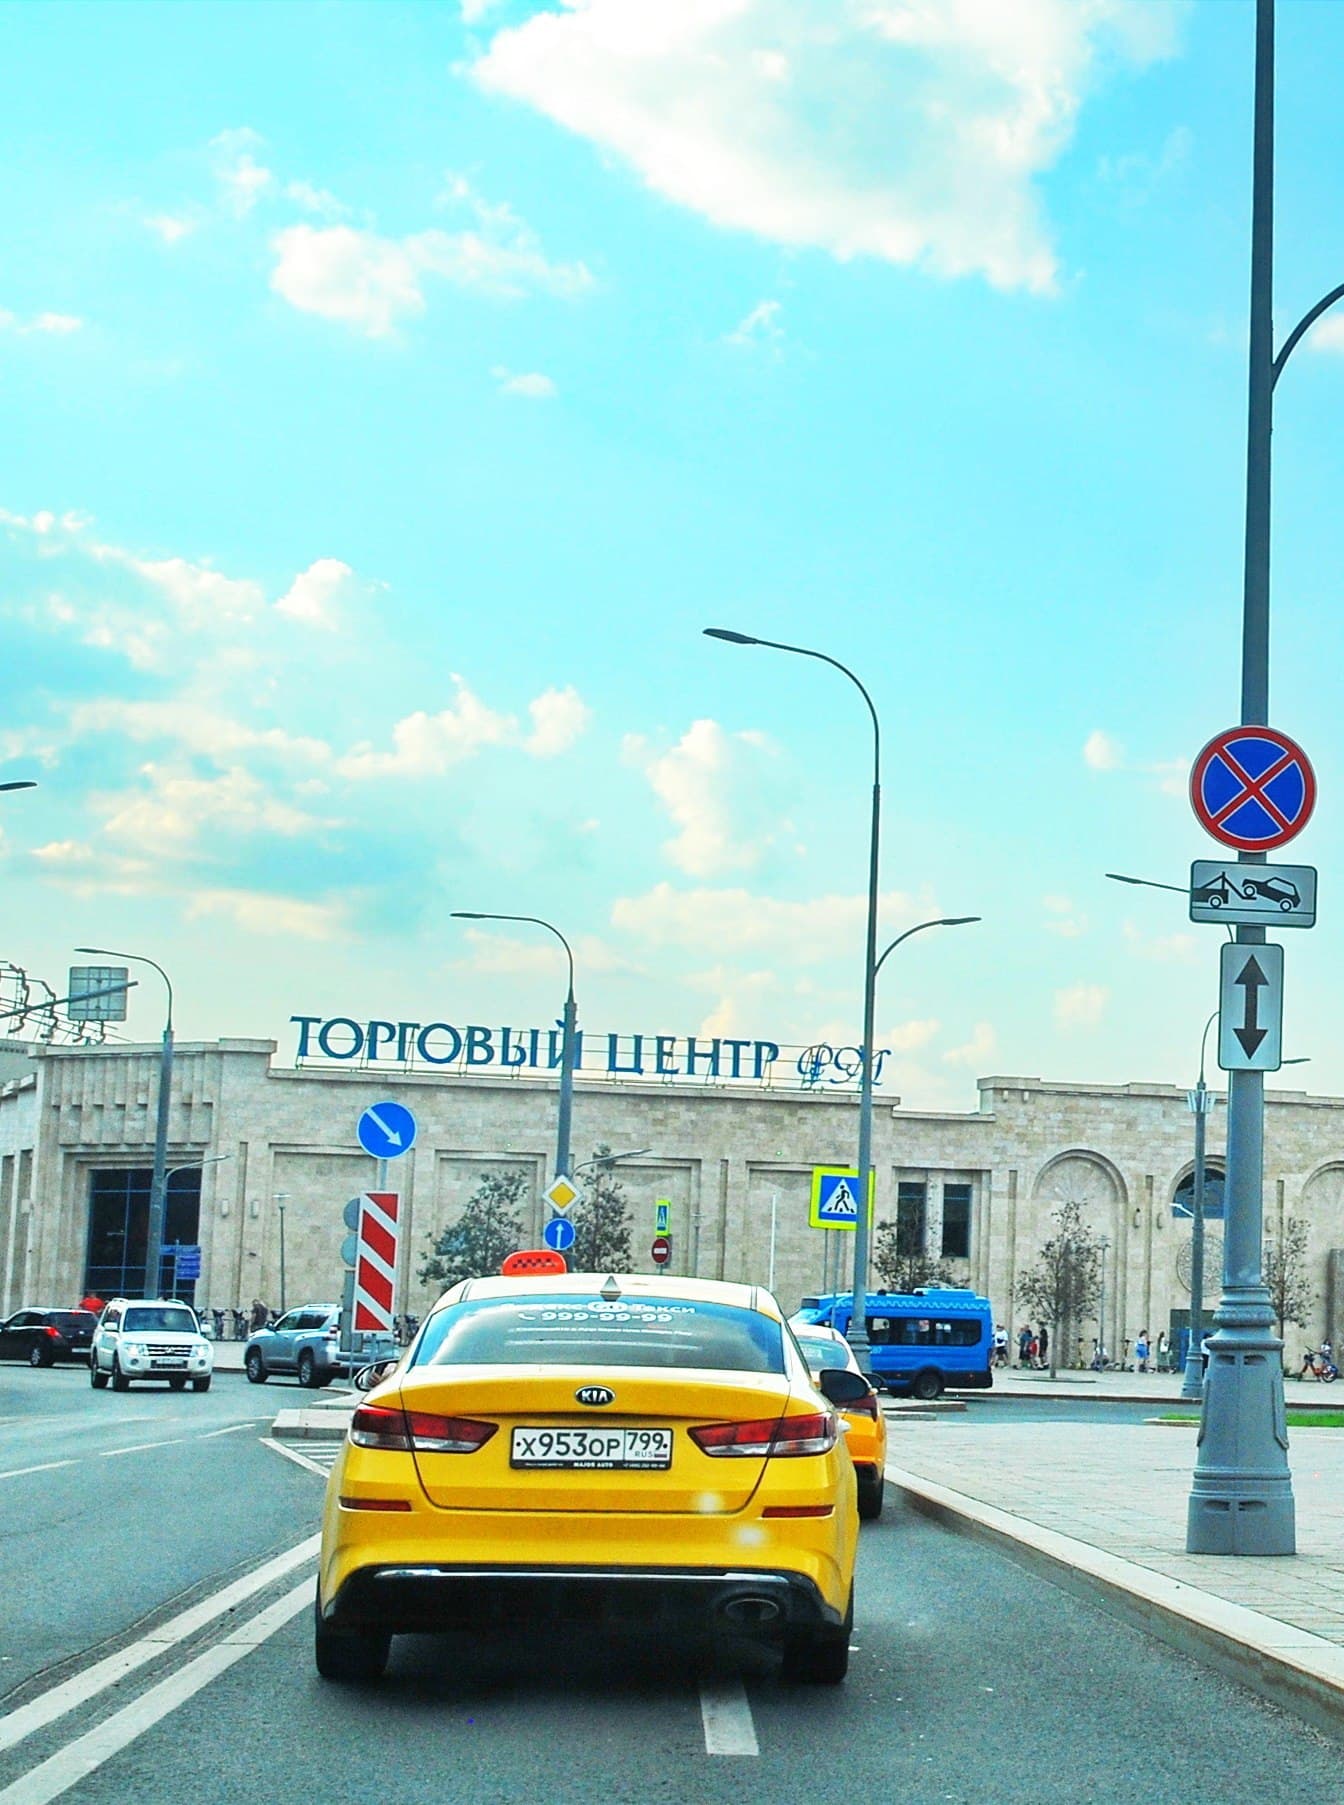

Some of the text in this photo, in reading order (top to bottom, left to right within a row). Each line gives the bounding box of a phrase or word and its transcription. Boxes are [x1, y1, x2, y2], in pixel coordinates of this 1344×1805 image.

[290, 1016, 584, 1070] ТОРГОВЫЙ
[607, 1033, 780, 1078] ЦЕНТР
[541, 1312, 674, 1322] 999-99-99
[581, 1390, 609, 1402] KIA
[520, 1432, 664, 1457] Х953ОР 799
